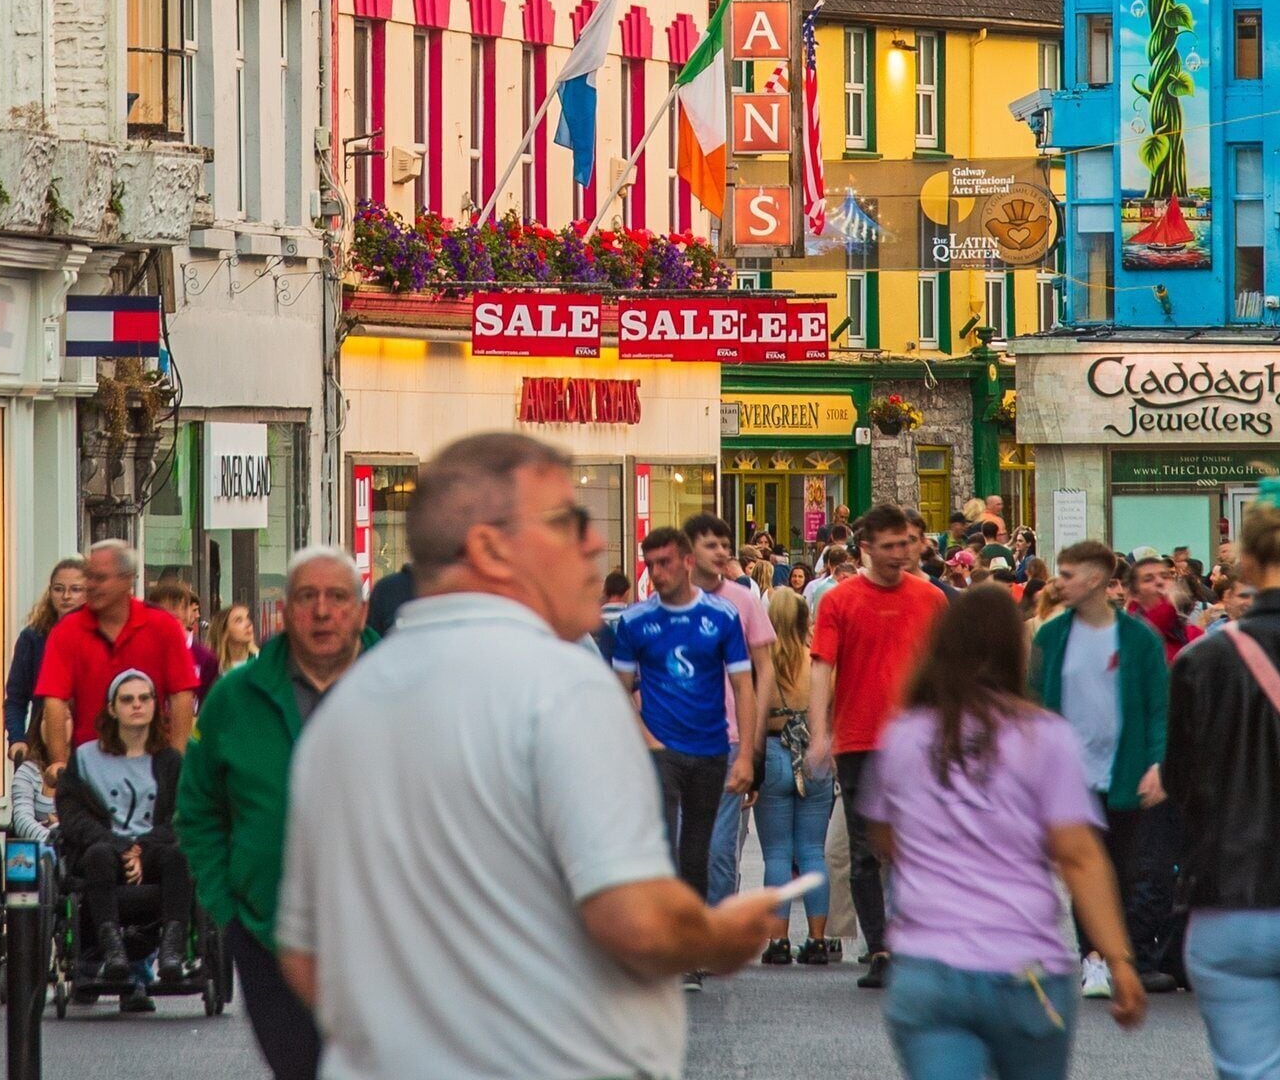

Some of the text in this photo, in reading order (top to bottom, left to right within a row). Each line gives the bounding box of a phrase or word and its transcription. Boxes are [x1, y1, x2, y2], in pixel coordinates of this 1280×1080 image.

[952, 167, 987, 178] Galway
[952, 175, 1015, 186] International
[952, 184, 1010, 195] Arts Festival
[932, 244, 1001, 262] QUARTER
[949, 233, 999, 250] LATIN
[475, 303, 599, 338] SALE
[621, 309, 738, 341] SALE
[740, 313, 786, 343] LE
[596, 379, 641, 424] RYANS
[826, 408, 849, 421] STORE
[1103, 405, 1273, 438] Jewellers
[221, 455, 272, 497] RIVER ISLAND
